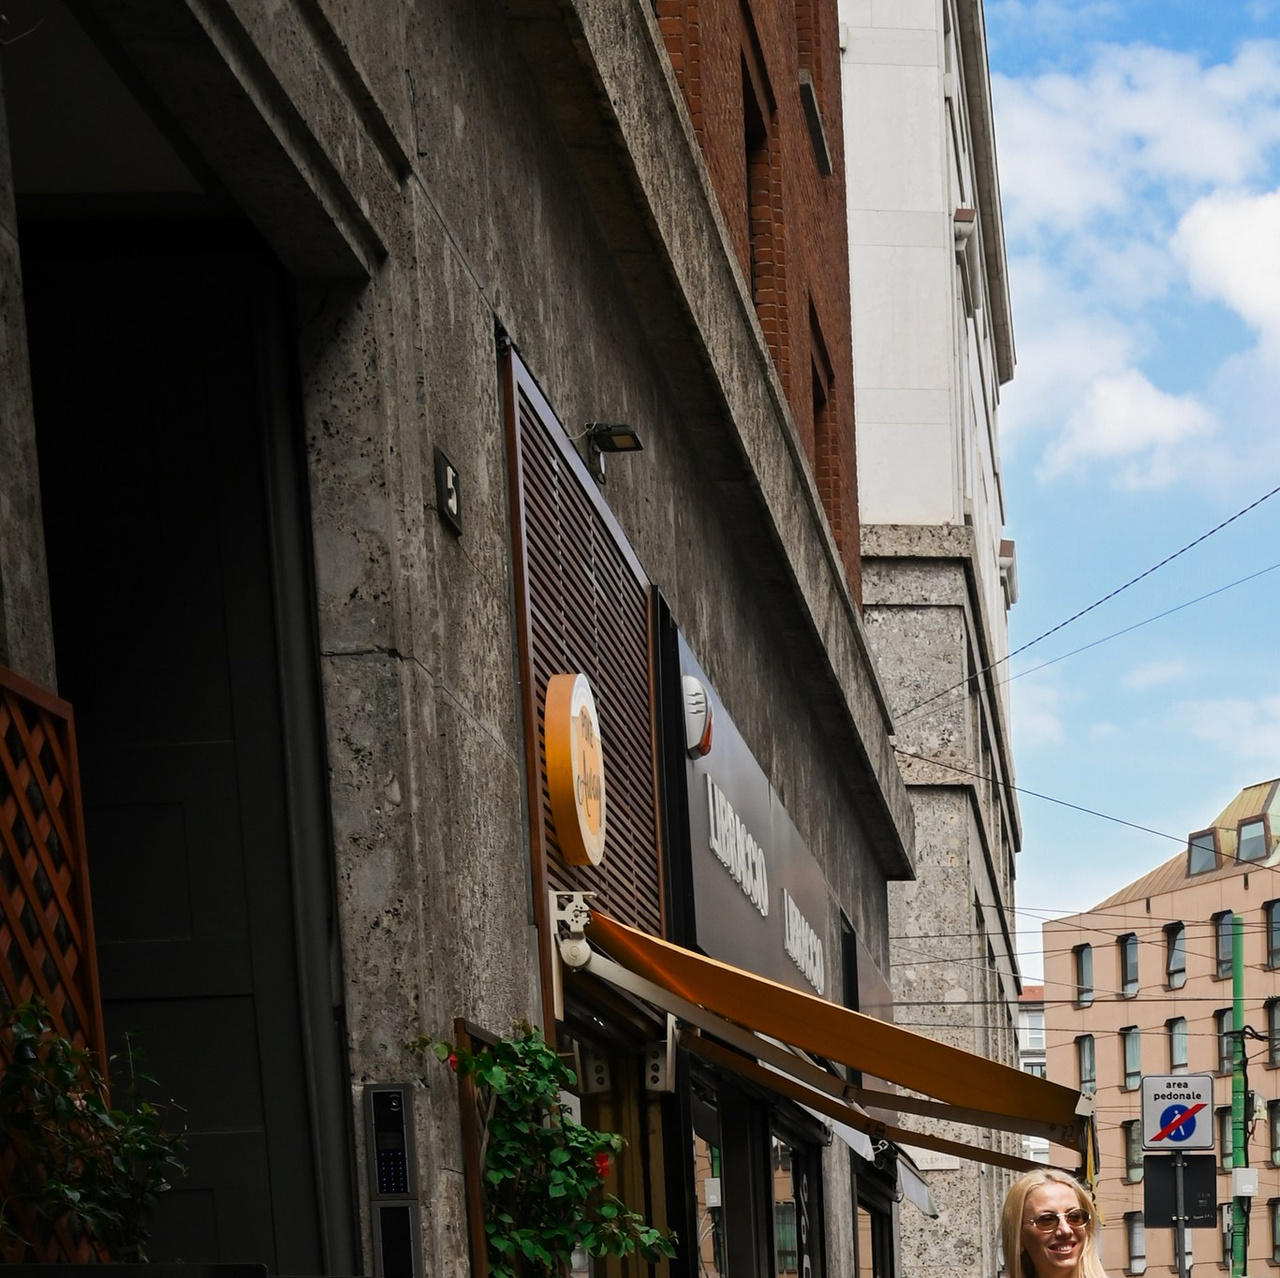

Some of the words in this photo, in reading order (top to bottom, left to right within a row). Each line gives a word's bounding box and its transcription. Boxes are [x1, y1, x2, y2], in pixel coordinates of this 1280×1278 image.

[446, 465, 457, 515] 5
[704, 772, 769, 917] LIBRACCIO
[1154, 1091, 1201, 1101] pedonale
[1166, 1081, 1188, 1089] area
